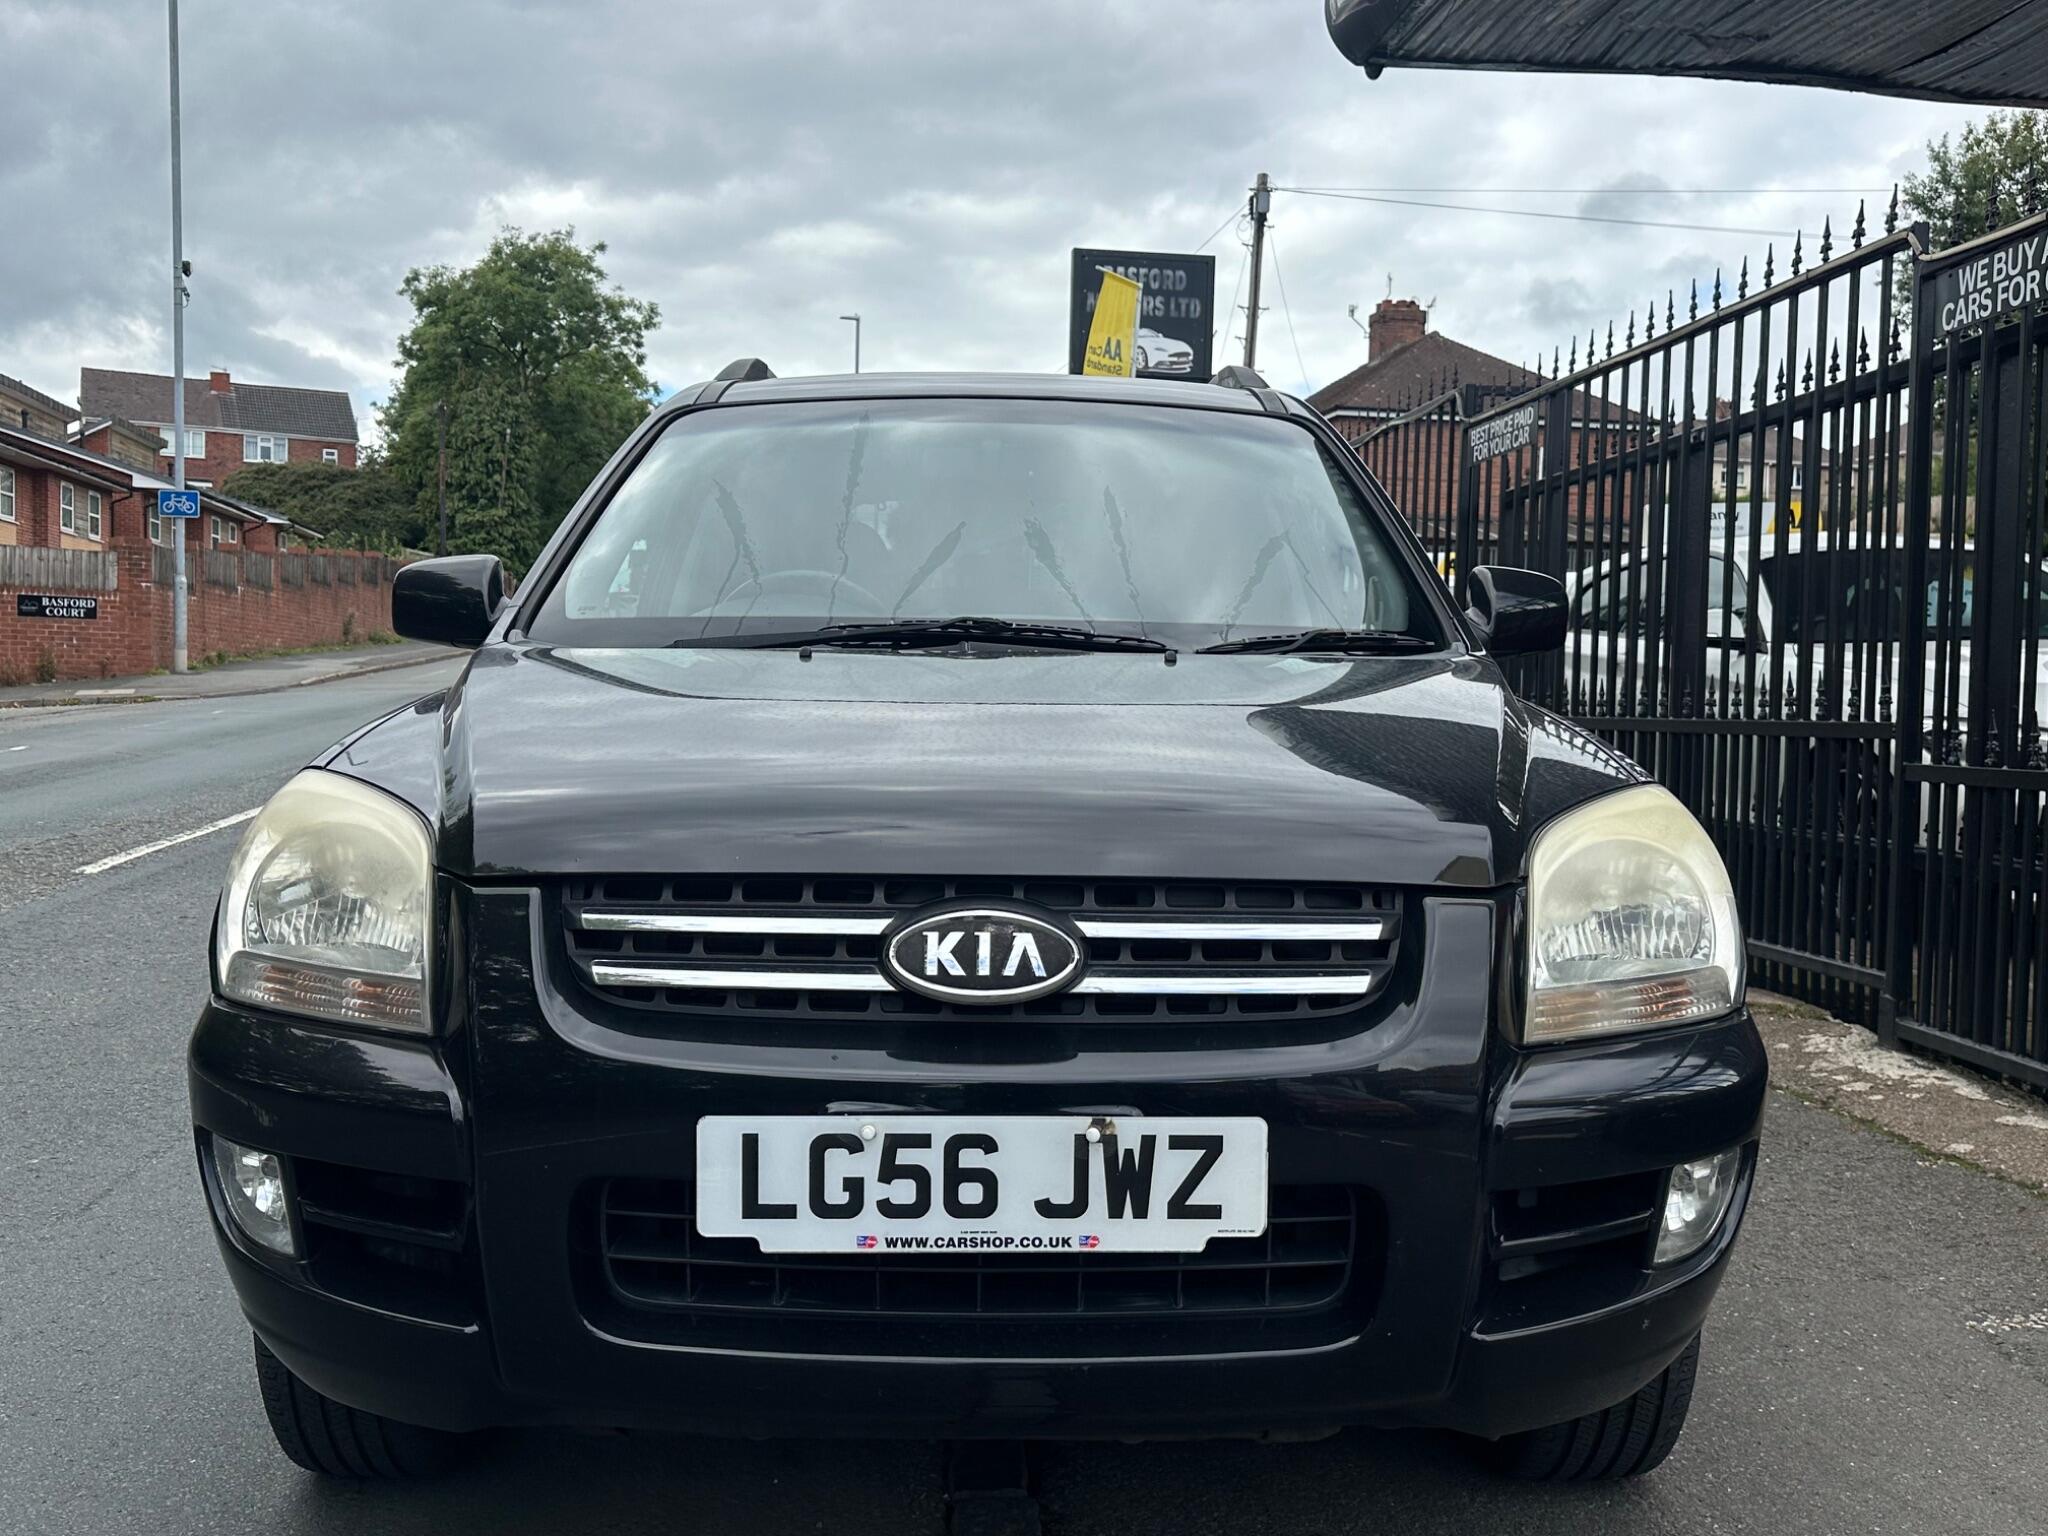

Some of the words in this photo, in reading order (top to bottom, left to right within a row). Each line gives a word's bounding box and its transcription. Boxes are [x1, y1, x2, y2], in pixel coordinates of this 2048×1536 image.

[1959, 257, 1989, 296] WE
[1992, 236, 2039, 283] BUY
[1169, 296, 1201, 319] LTD
[1941, 287, 1992, 331] CARS
[1996, 269, 2040, 312] FOR
[1471, 424, 1490, 446] BEST
[1490, 413, 1513, 438] PRICE
[1514, 406, 1534, 430] PAID
[1473, 442, 1489, 462] FOR
[1489, 433, 1511, 456] YOUR
[1512, 426, 1530, 447] CAR
[42, 597, 95, 608] BASFORD
[45, 607, 86, 617] COURT
[922, 931, 1048, 977] KIA
[741, 1133, 999, 1220] LG56
[1033, 1133, 1224, 1220] JWZ
[884, 1236, 1073, 1249] WWW.CARSHOP.CO.UK
